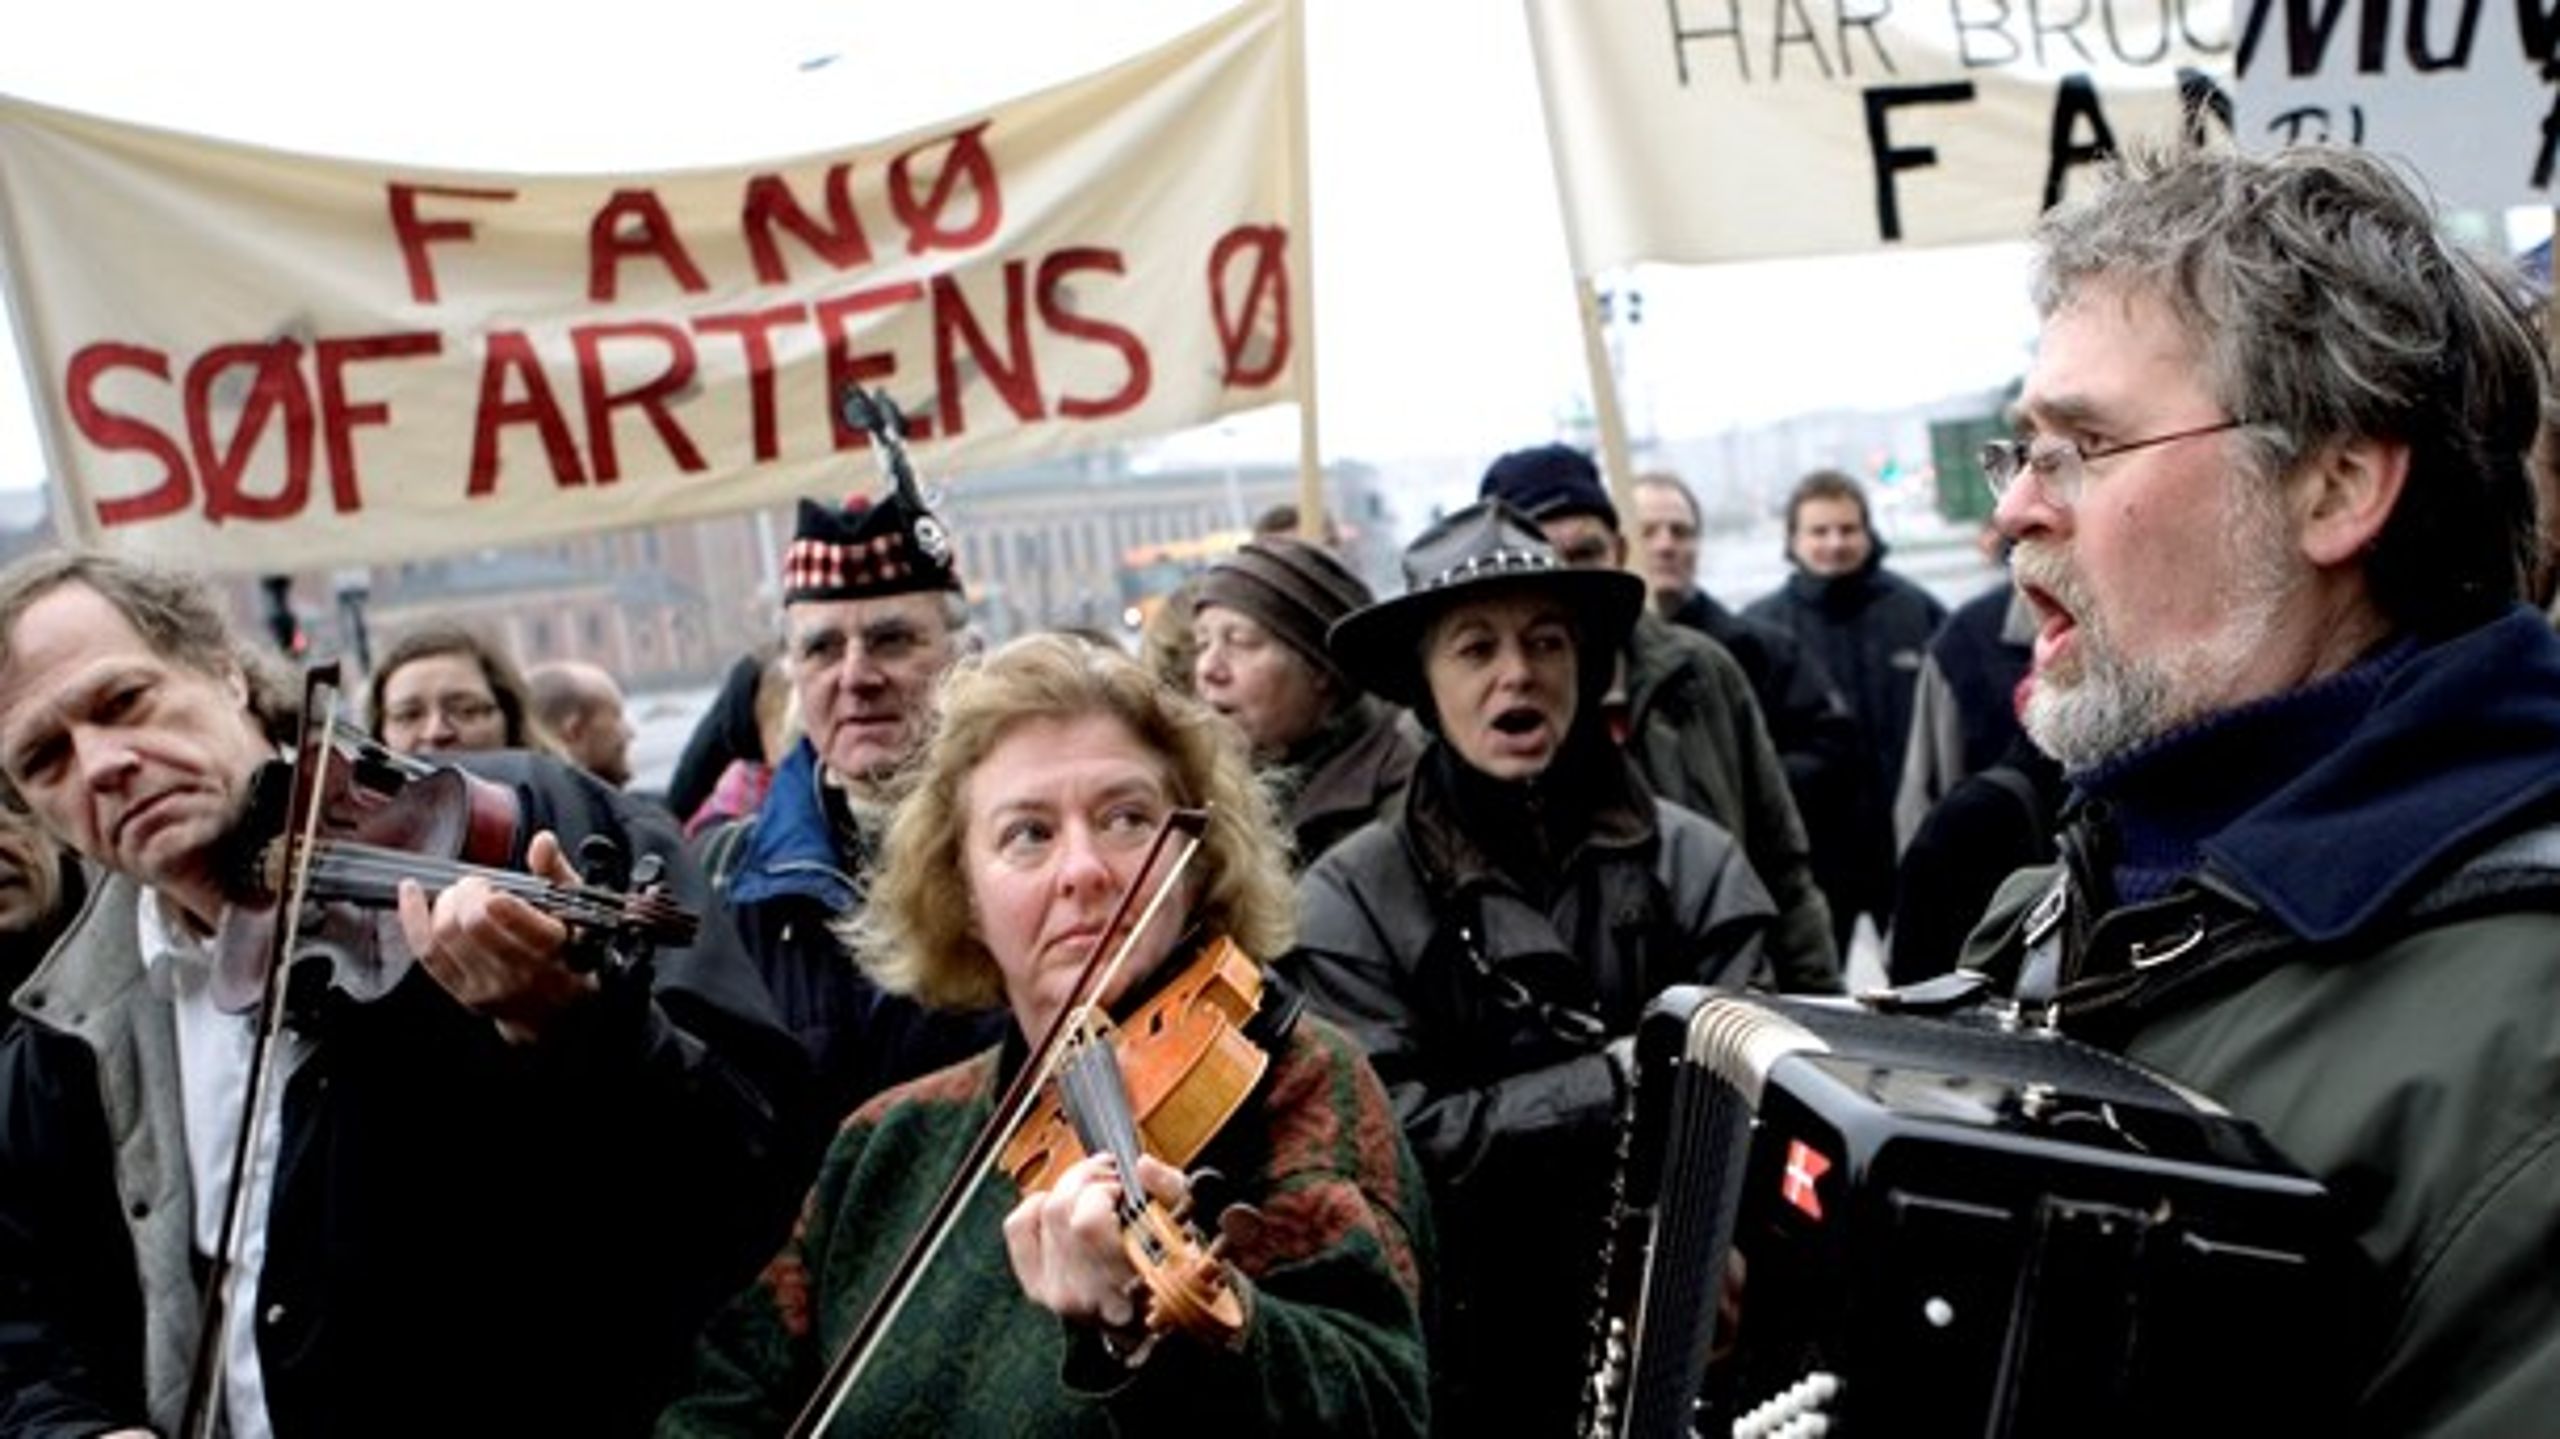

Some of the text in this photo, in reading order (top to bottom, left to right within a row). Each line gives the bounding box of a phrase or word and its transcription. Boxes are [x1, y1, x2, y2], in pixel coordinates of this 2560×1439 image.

[1668, 0, 1898, 86] HAR
[387, 120, 1002, 303] FANØ
[66, 225, 1291, 526] SØFARTENS Ø
